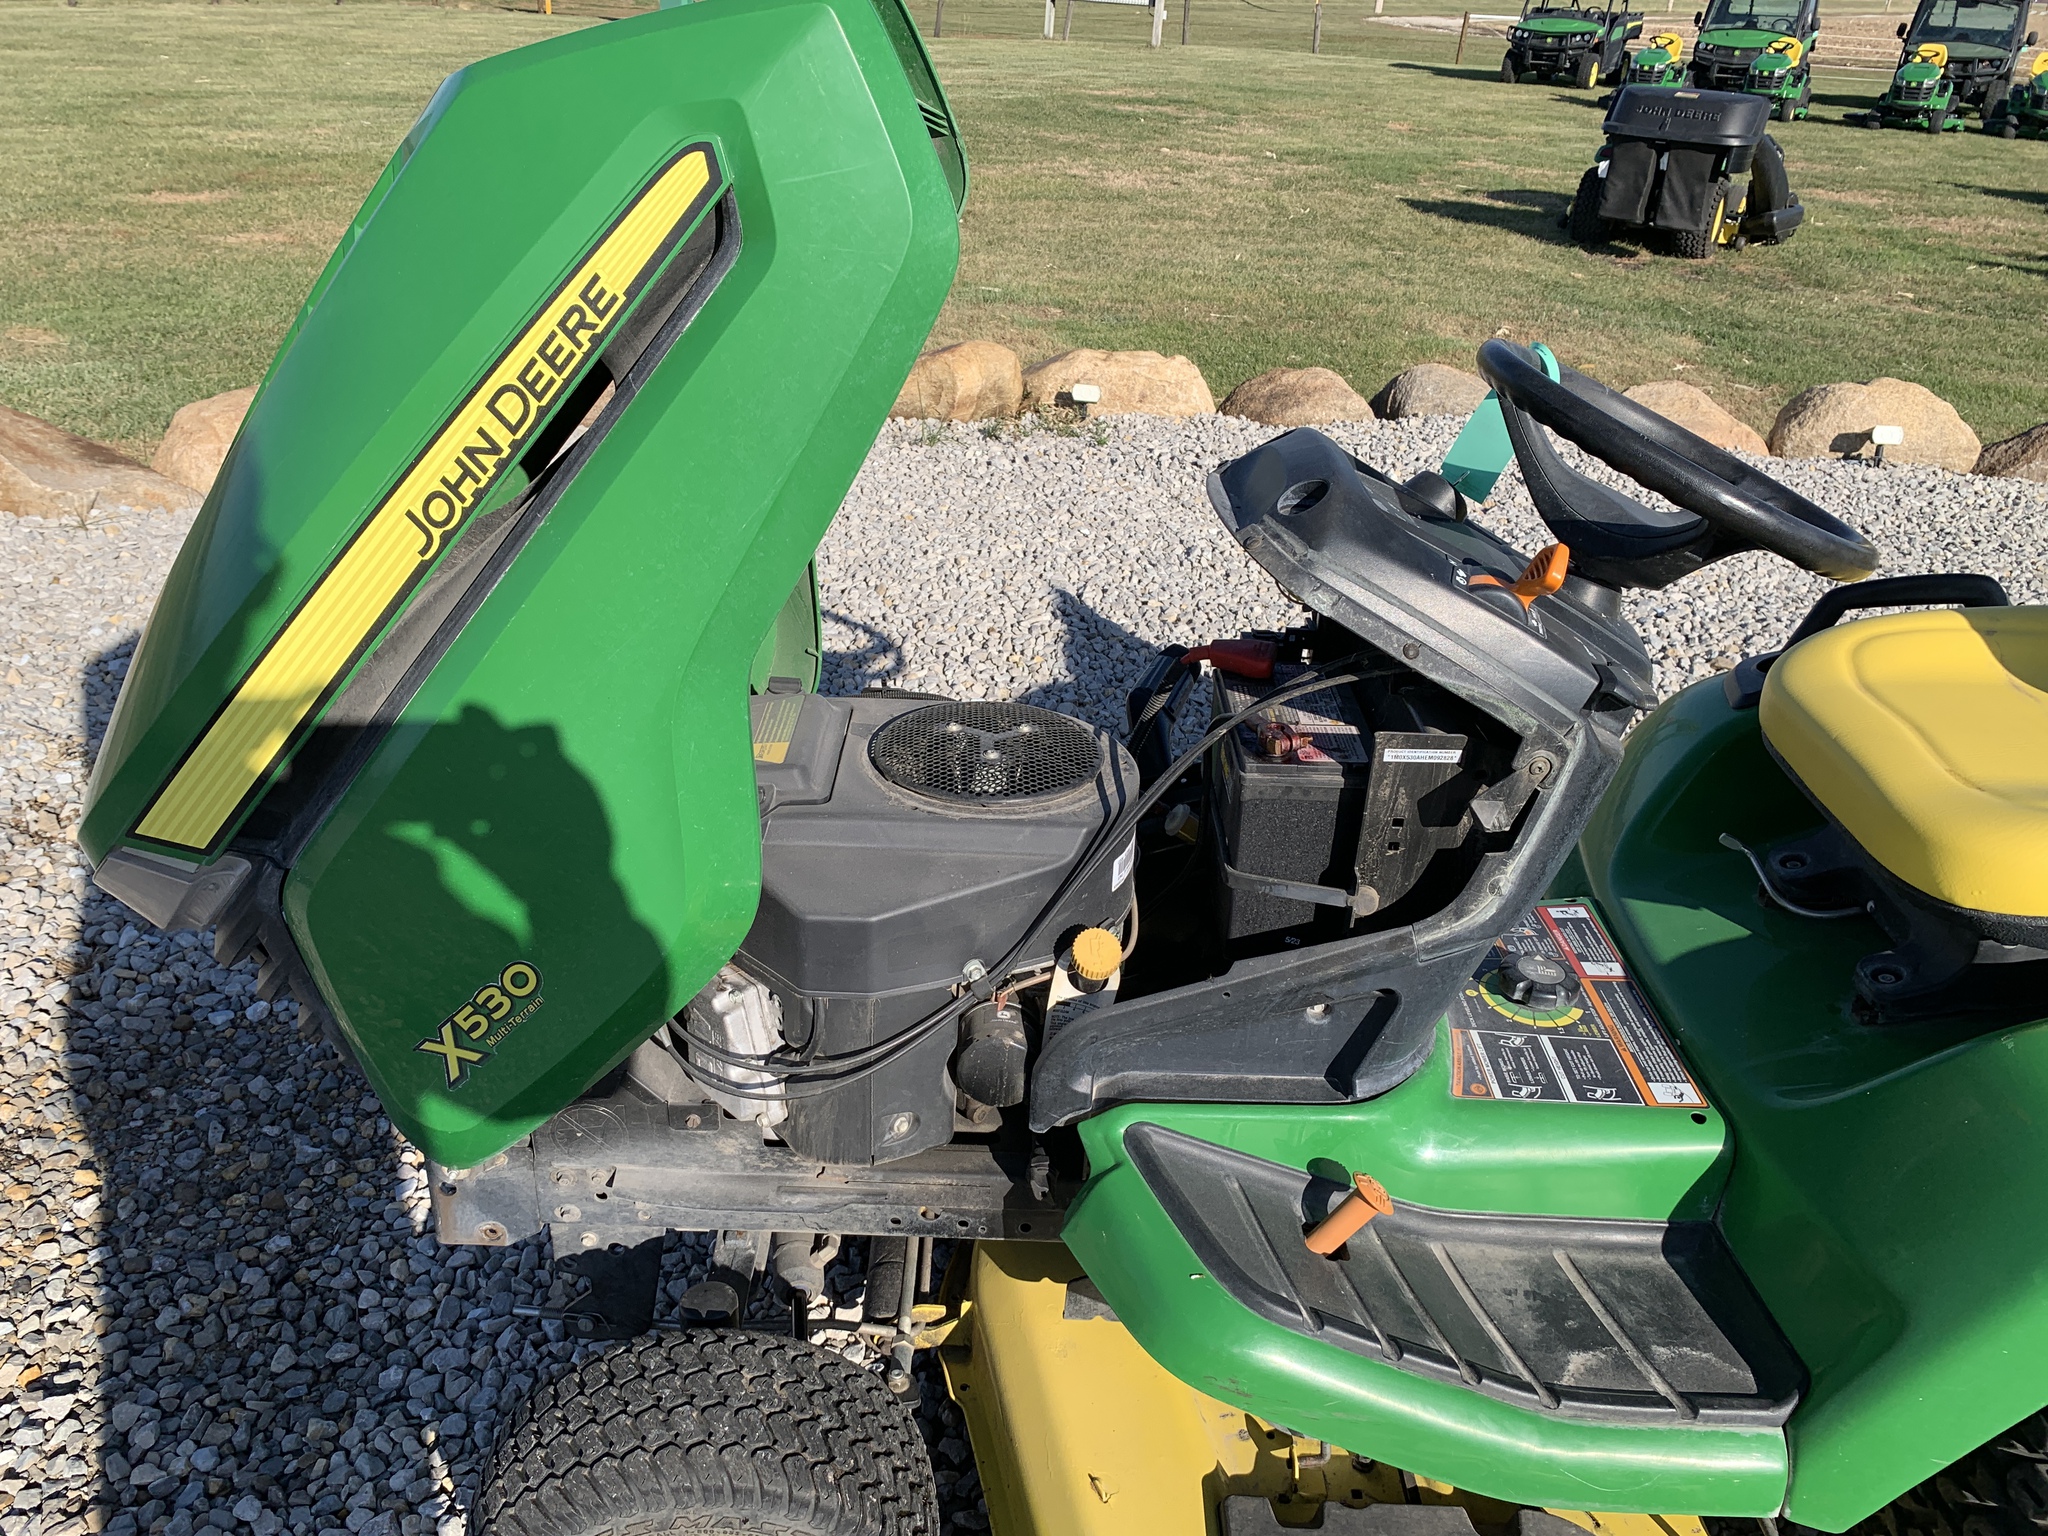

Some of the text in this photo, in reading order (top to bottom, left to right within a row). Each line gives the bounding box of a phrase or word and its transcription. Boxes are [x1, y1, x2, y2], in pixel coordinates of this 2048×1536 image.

[1675, 108, 1722, 123] DEERE
[404, 271, 620, 558] JOHN DEERE
[417, 962, 540, 1085] X530
[485, 996, 544, 1048] Multi-Terrain
[1608, 1025, 1624, 1049] WARNING
